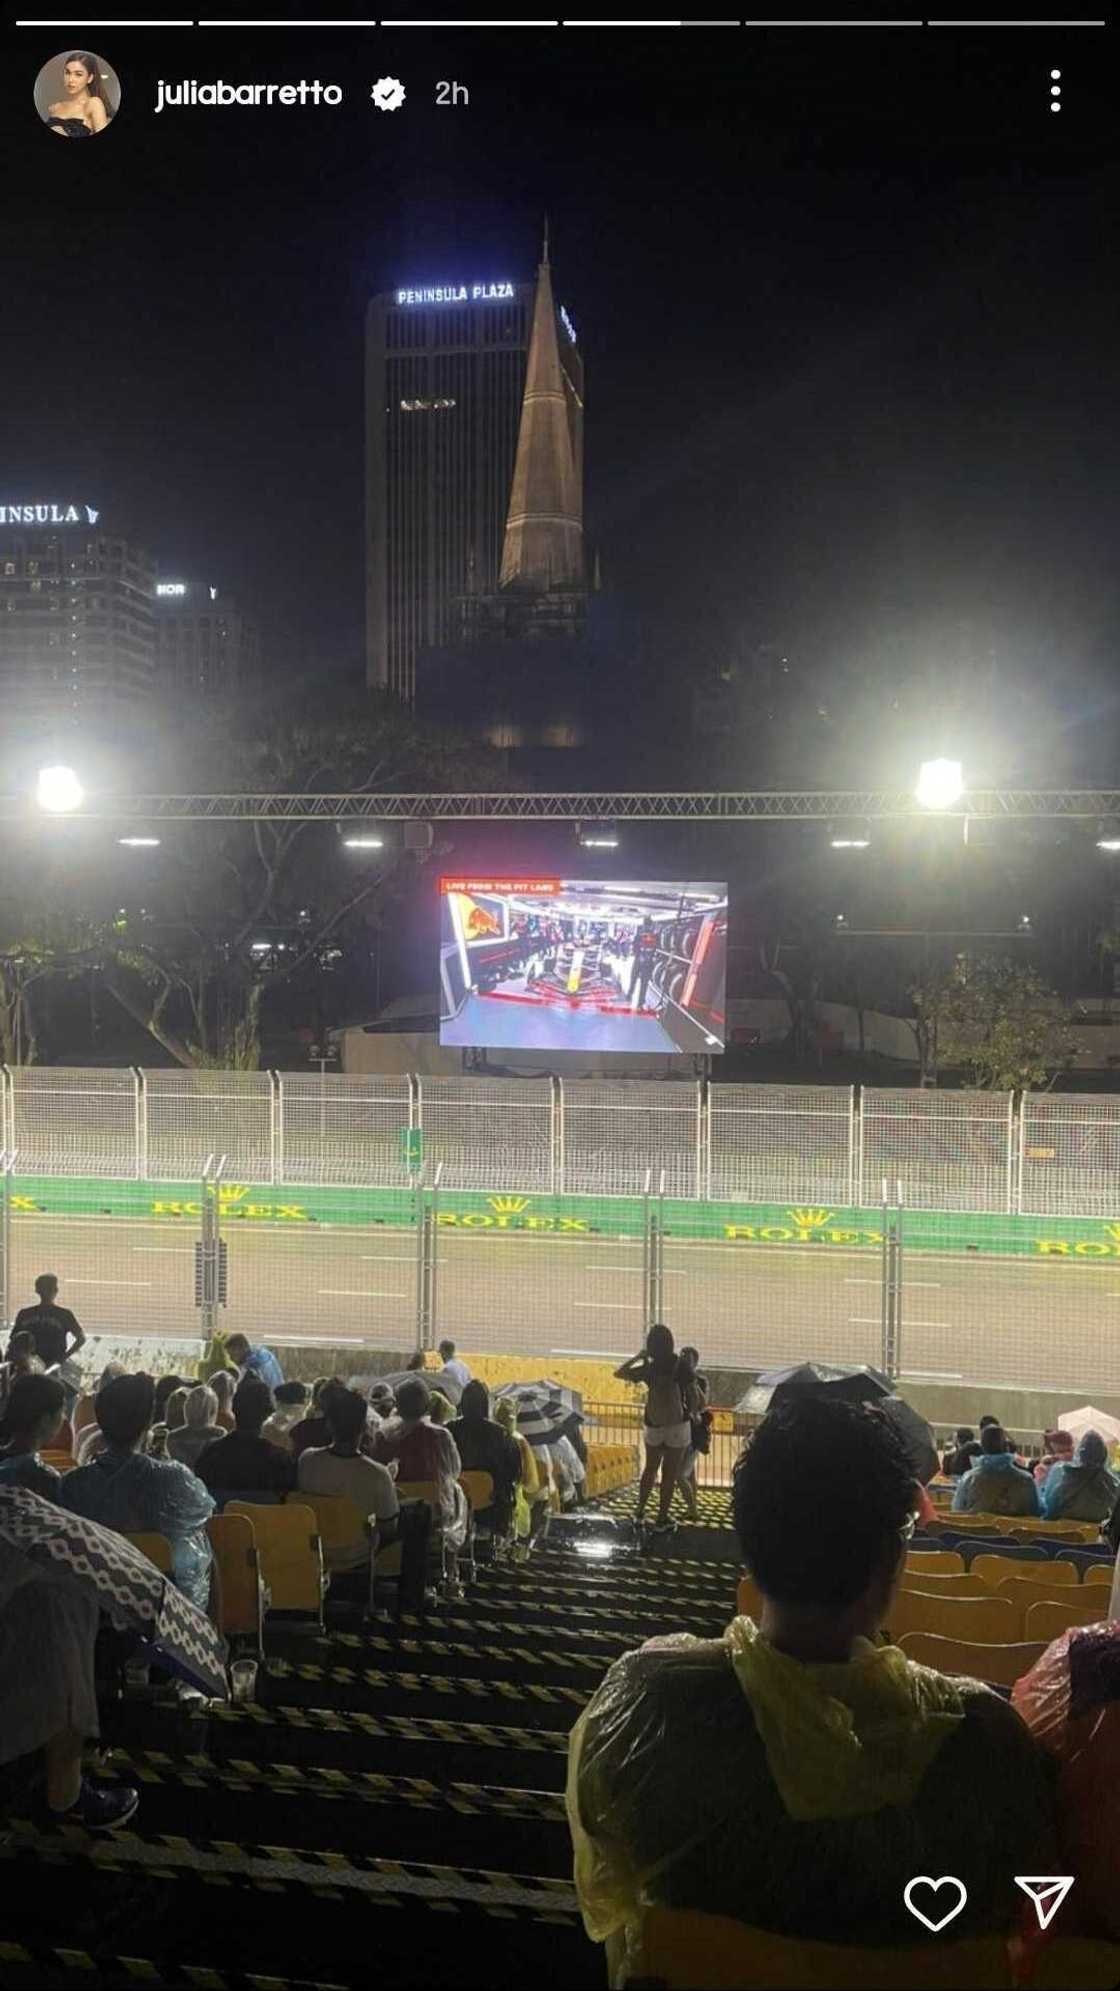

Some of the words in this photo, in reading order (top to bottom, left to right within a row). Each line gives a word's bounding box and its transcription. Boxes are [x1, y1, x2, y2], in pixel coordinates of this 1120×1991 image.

[398, 286, 468, 304] PENINSULA
[473, 283, 514, 299] PLAZA
[447, 882, 466, 890] LIVE
[467, 882, 493, 890] FROM
[495, 883, 512, 891] THE
[513, 883, 529, 891] PIT
[432, 1213, 589, 1231] ROLEX
